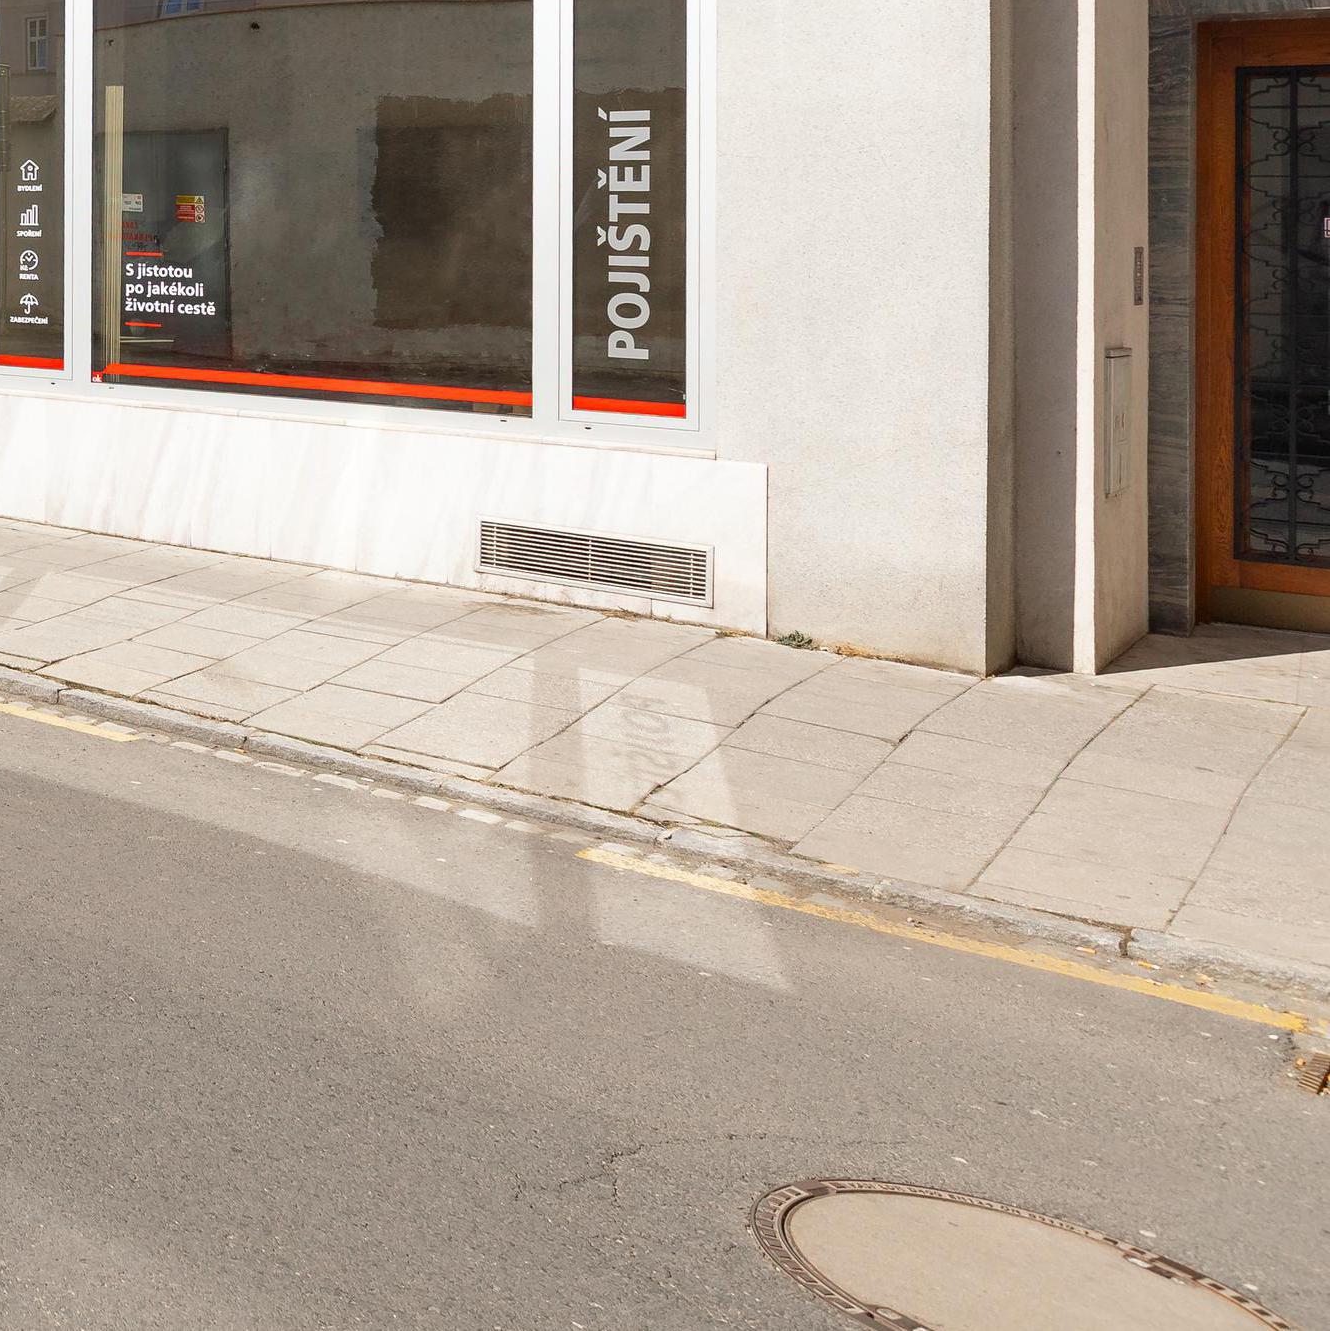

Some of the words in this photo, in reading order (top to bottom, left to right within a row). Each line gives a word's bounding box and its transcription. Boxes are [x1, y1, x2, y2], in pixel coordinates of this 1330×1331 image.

[597, 107, 651, 360] POJIŠTĚNÍ
[19, 273, 39, 281] RENTA
[125, 263, 134, 276] S
[136, 263, 193, 279] jistotou
[125, 284, 144, 297] po
[146, 281, 204, 298] jakékoli
[125, 298, 174, 314] životní
[177, 301, 216, 316] cestě
